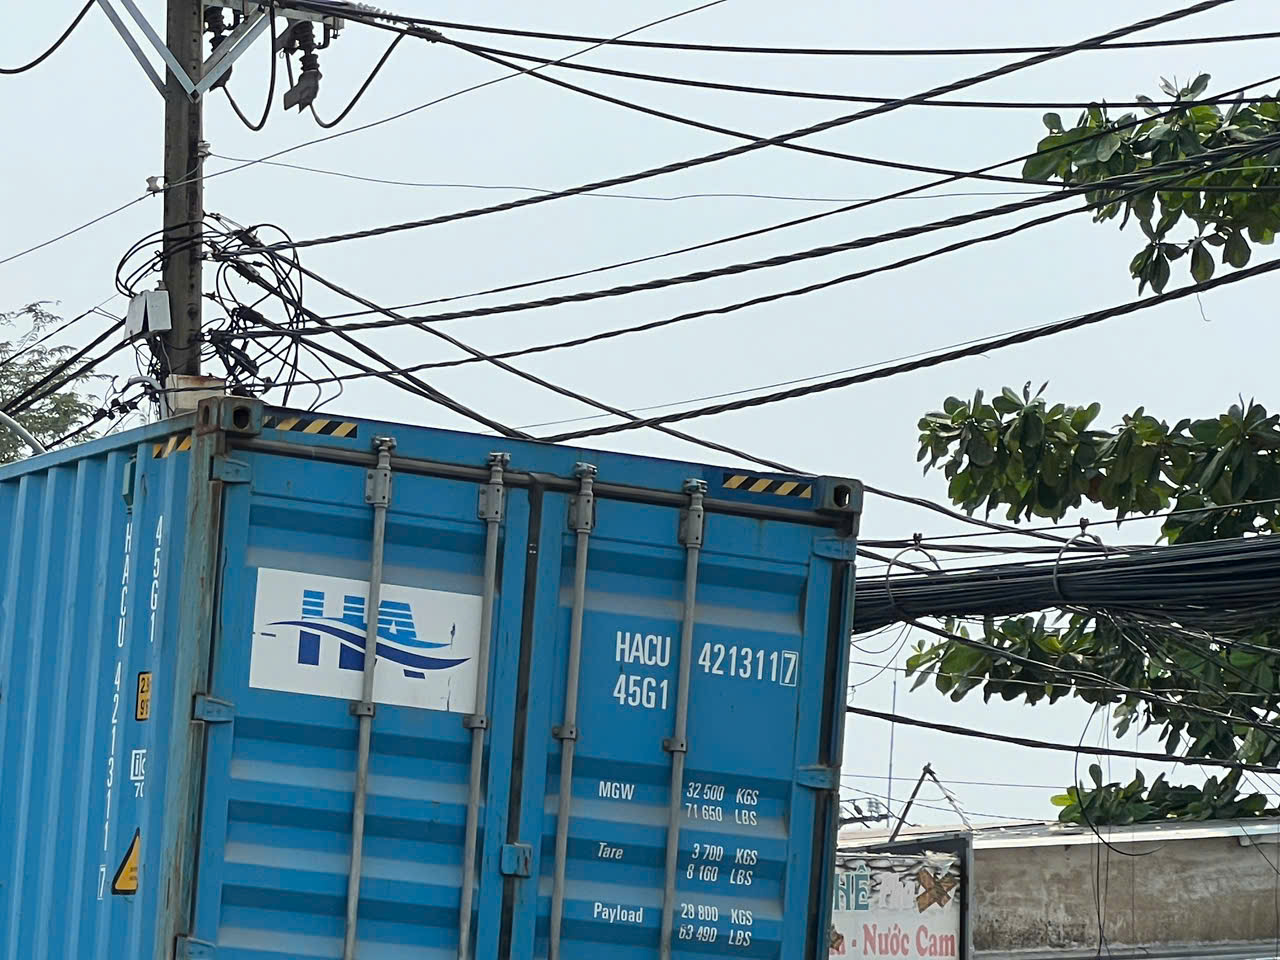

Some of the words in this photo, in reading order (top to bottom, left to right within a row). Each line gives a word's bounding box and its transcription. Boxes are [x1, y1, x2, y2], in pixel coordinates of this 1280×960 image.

[117, 523, 132, 648] HACU
[149, 515, 163, 642] 45G1
[615, 631, 671, 667] HACU
[613, 674, 669, 710] 45G1
[599, 781, 634, 800] MGW
[687, 782, 700, 798] 32
[703, 784, 725, 801] 500
[736, 788, 759, 806] KGS
[685, 803, 698, 819] 71
[702, 805, 723, 822] 650
[735, 809, 758, 826] LBS
[598, 842, 624, 860] Tare
[692, 843, 700, 859] 3
[703, 844, 724, 861] 700
[735, 848, 758, 865] KGS
[686, 863, 694, 879] 8
[699, 865, 719, 882] 160
[730, 869, 753, 886] LBS
[593, 902, 644, 924] Payload
[681, 904, 695, 919] 28
[698, 905, 719, 922] 800
[730, 909, 753, 926] KGS
[679, 924, 694, 940] 63
[696, 926, 718, 943] 490
[728, 930, 752, 946] LBS
[863, 923, 910, 957] Nước
[916, 925, 956, 957] Cam
